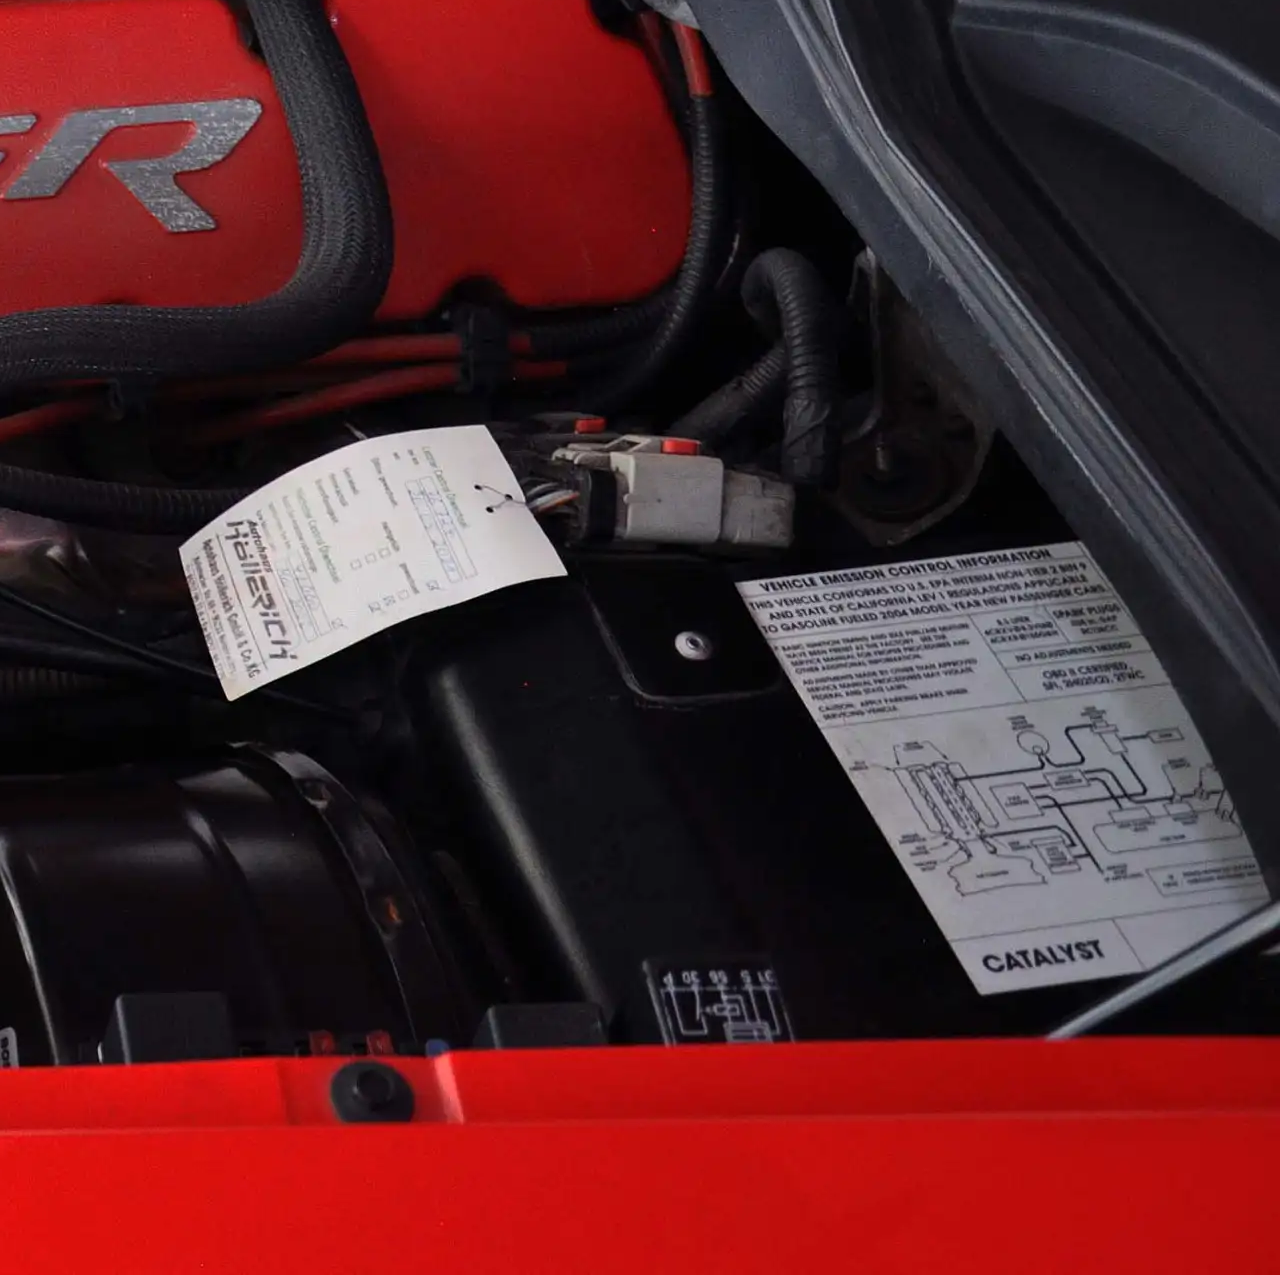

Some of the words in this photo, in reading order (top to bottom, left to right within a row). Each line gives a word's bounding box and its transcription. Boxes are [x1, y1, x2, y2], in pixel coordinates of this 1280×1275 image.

[248, 520, 272, 573] Autohaus
[758, 576, 817, 593] VEHICLE
[818, 568, 886, 585] EMISSION
[887, 559, 955, 577] CONTROL
[955, 547, 1052, 569] INFORMATION
[748, 599, 775, 610] THIS
[774, 593, 821, 607] VEHICLE
[821, 585, 890, 601] CONFORMS
[889, 583, 906, 593] TO
[767, 609, 794, 621] AND
[794, 605, 828, 617] STATE
[827, 603, 846, 613] OF
[845, 594, 917, 611] CALIFORNIA
[945, 581, 1023, 599] REGULATIONS
[760, 623, 779, 634] TO
[778, 616, 839, 632] GASOLINE
[837, 611, 879, 624] FUELED
[878, 607, 909, 619] 2004
[908, 602, 953, 616] MODEL
[952, 599, 982, 610] YEAR
[982, 939, 1107, 976] CATALYST
